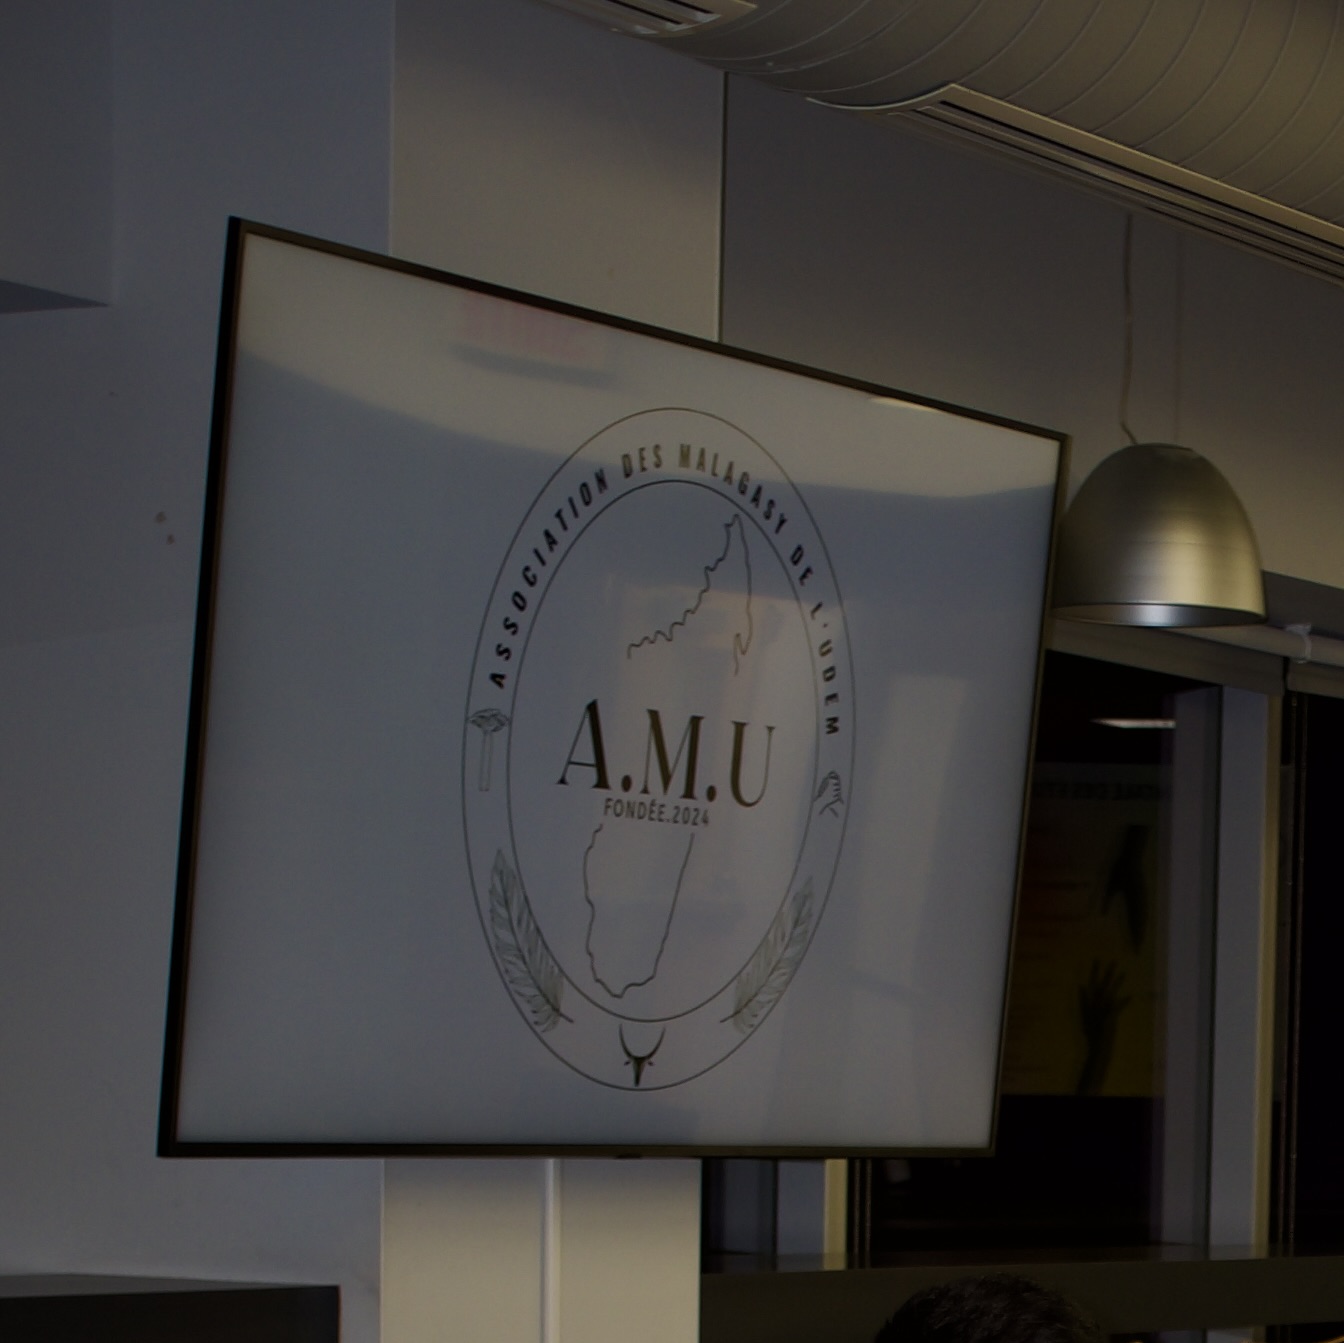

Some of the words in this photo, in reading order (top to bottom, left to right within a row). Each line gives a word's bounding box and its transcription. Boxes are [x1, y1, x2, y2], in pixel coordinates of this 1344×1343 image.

[490, 468, 608, 688] ASSOCIATION
[621, 443, 663, 479] DES
[678, 443, 787, 535] MALAGASY
[789, 544, 814, 587] DE
[555, 698, 776, 808] A.M.U
